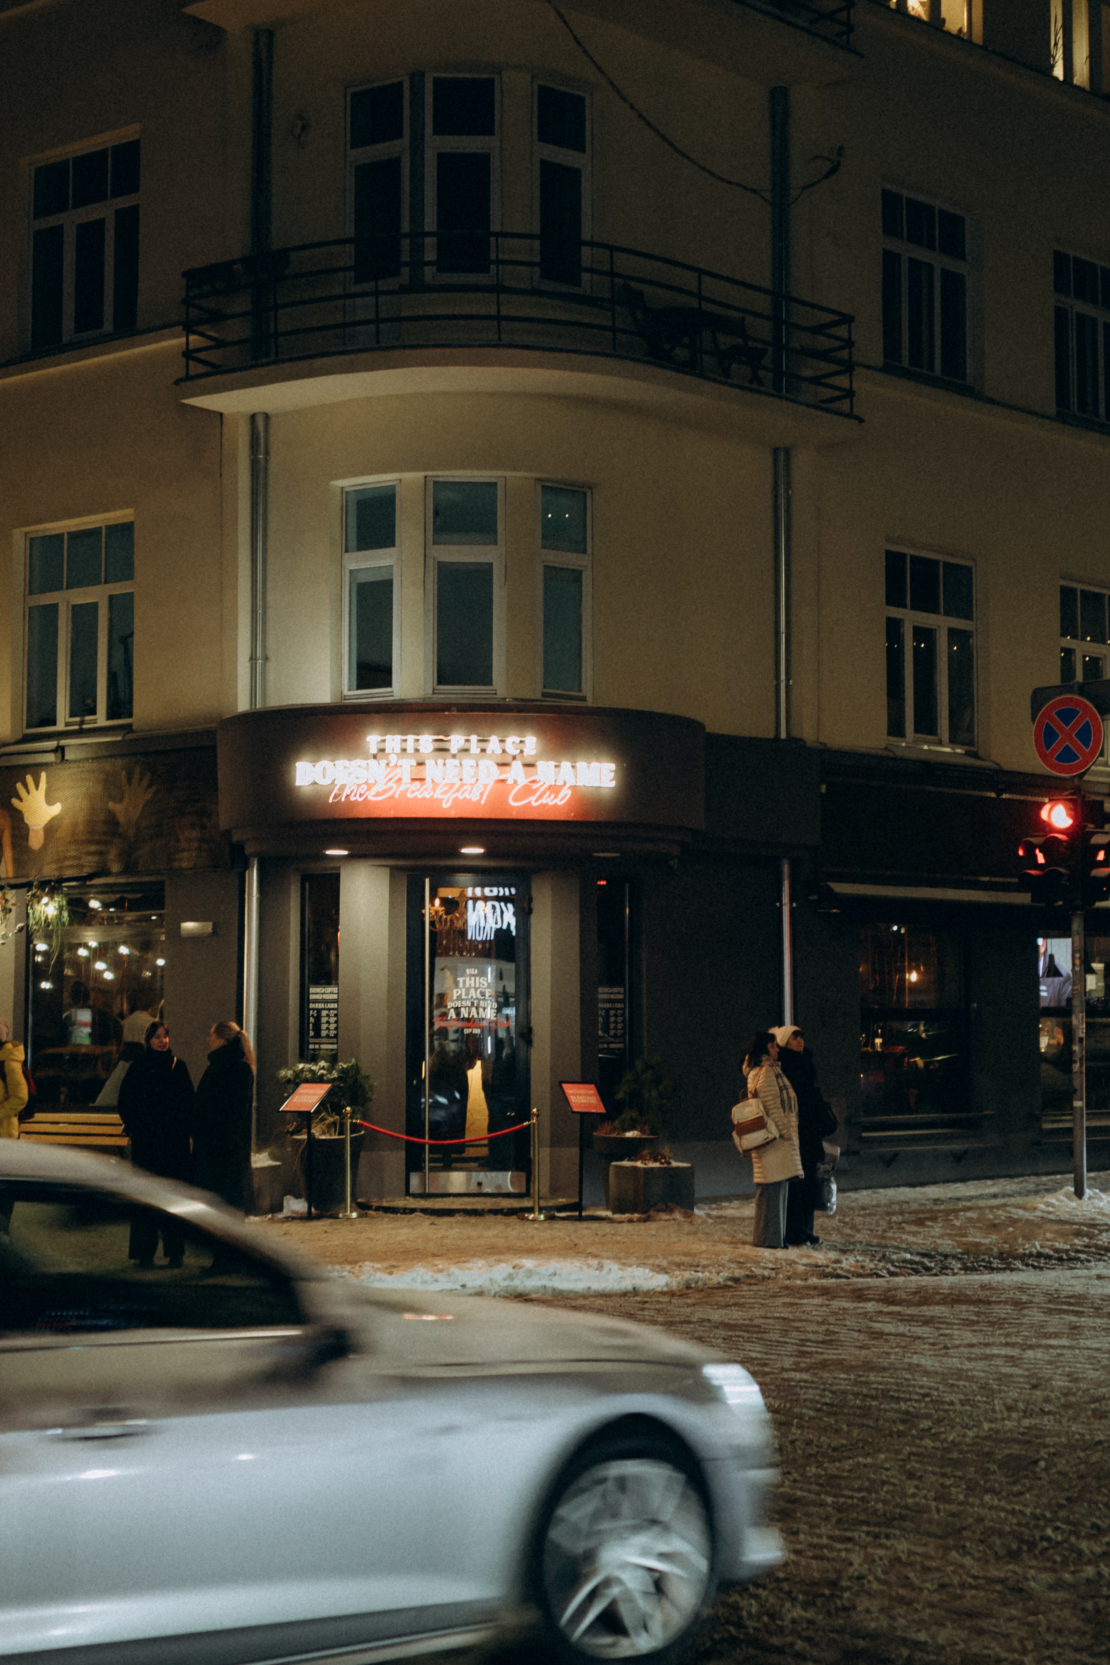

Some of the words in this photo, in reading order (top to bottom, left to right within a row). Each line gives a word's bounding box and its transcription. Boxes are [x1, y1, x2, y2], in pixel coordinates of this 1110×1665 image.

[366, 734, 434, 754] THIS
[450, 734, 537, 756] PLACE
[295, 754, 416, 786] DOESN'T
[425, 758, 500, 785] NEED
[506, 760, 526, 785] A
[536, 760, 616, 788] NAME
[508, 776, 572, 807] Club
[457, 976, 488, 988] THIS
[453, 988, 492, 999] PLACE
[448, 1000, 478, 1008] DOESN'T
[480, 1000, 498, 1008] NEED
[448, 1008, 456, 1020] A
[460, 1008, 497, 1020] NAME
